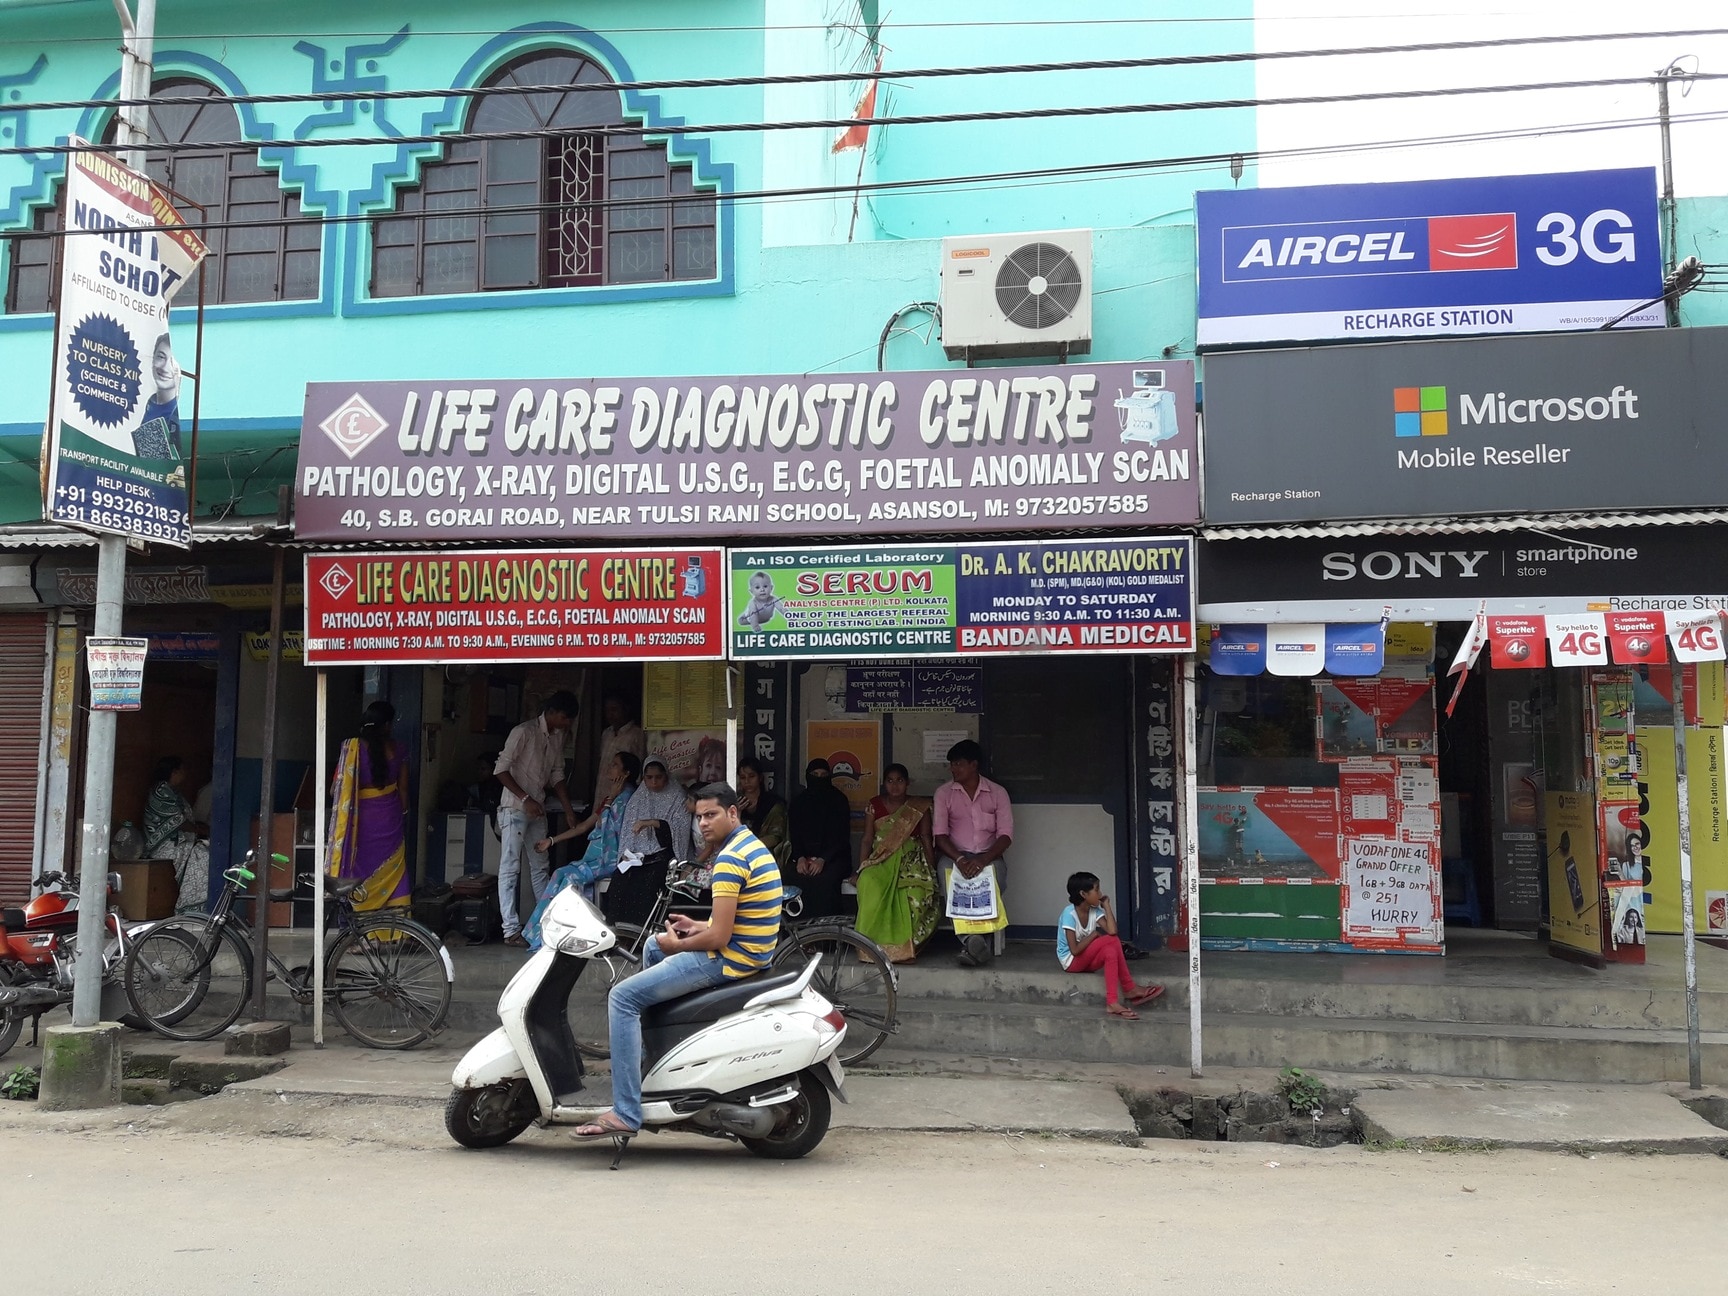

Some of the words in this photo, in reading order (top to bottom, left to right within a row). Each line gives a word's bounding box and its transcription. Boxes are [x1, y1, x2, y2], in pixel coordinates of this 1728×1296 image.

[76, 150, 149, 202] ADMISSION
[75, 199, 142, 257] NORTH
[1238, 231, 1416, 269] AIRCEL
[1535, 209, 1636, 266] 3G
[71, 272, 117, 301] AFFILIATED
[119, 294, 130, 307] TO
[132, 299, 155, 317] CBSE
[1344, 312, 1436, 331] RECHARGE
[1441, 308, 1514, 327] STATION
[82, 337, 128, 362] NURSERY
[73, 350, 87, 363] TO
[89, 356, 122, 378] CLASS
[124, 367, 139, 381] XII
[80, 371, 119, 390] (SCIENCE
[121, 383, 127, 392] &
[77, 383, 128, 409] COMMERCE)
[1460, 386, 1639, 425] Microsoft
[398, 388, 498, 455] LIFE
[504, 386, 622, 455] CARE
[629, 381, 898, 452] DIAGNOSTIC
[920, 373, 1099, 448] CENTRE
[60, 447, 100, 465] TRANSPORT
[100, 457, 129, 473] FACILITY
[130, 466, 164, 482] AVAILABLE
[1398, 447, 1476, 469] Mobile
[1483, 444, 1571, 466] Reseller
[96, 475, 123, 491] HELP
[125, 483, 151, 499] DESK
[303, 466, 467, 503] PATHOLOGY,
[475, 465, 557, 502] X-RAY,
[565, 463, 670, 497] DIGITAL
[679, 462, 765, 498] U.S.G.,
[773, 460, 852, 496] E.C.G,
[860, 457, 962, 490] FOETAL
[970, 453, 1104, 487] ANOMALY
[1112, 449, 1190, 482] SCAN
[56, 484, 86, 498] +91
[92, 490, 191, 527] 9932621836
[1231, 491, 1282, 505] Recharge
[1284, 489, 1321, 501] Station
[56, 505, 85, 521] +91
[91, 510, 191, 543] 8653839325
[340, 509, 371, 531] 40,
[379, 510, 419, 527] S.B.
[425, 508, 494, 526] GORAI
[500, 508, 566, 529] ROAD,
[572, 506, 631, 525] NEAR
[637, 505, 701, 524] TULSI
[707, 503, 760, 523] RANI
[766, 503, 862, 524] SCHOOL,
[868, 500, 977, 523] ASANSOL,
[984, 500, 1010, 517] M:
[1016, 494, 1149, 516] 9732057585
[746, 556, 766, 566] An
[770, 555, 795, 566] ISO
[799, 554, 861, 565] Certified
[866, 553, 944, 564] Laboratory
[994, 552, 1012, 575] A.
[1018, 551, 1037, 575] K.
[1042, 547, 1184, 573] CHAKRAVORTY
[1322, 550, 1489, 581] SONY
[1516, 544, 1638, 567] smartphone
[356, 562, 394, 604] LIFE
[399, 560, 452, 603] CARE
[458, 558, 588, 603] DIAGNOSTIC
[600, 557, 676, 600] CENTRE
[796, 569, 933, 596] SERUM
[1127, 575, 1147, 586] GOLD
[1148, 574, 1184, 586] MEDALIST
[1517, 565, 1547, 578] store
[784, 599, 828, 608] ANALYSIS
[830, 599, 866, 608] CENTRE
[869, 599, 881, 608] (P)
[883, 598, 903, 607] LTD.
[905, 597, 949, 606] KOLKATA
[992, 596, 1053, 608] MONDAY
[1057, 595, 1077, 606] TO
[1080, 593, 1157, 605] SATURDAY
[1610, 597, 1687, 611] Recharge
[322, 611, 393, 630] PATHOLOGY,
[396, 611, 433, 629] X-RAY,
[436, 610, 482, 626] DIGITAL
[565, 608, 609, 625] FOETAL
[613, 607, 670, 624] ANOMALY
[673, 607, 705, 624] SCAN
[784, 611, 807, 620] ONE
[809, 611, 823, 619] OF
[826, 610, 848, 619] THE
[850, 609, 898, 618] LARGEST
[901, 608, 949, 617] REFERAL
[788, 620, 823, 629] BLOOD
[826, 619, 867, 628] TESTING
[870, 618, 899, 627] LAB.
[902, 618, 914, 626] IN
[916, 617, 946, 626] INDIA
[970, 611, 1031, 623] MORNING
[1034, 610, 1061, 622] 9:30
[1064, 609, 1091, 621] A.M.
[1094, 609, 1112, 620] TO
[1115, 608, 1150, 619] 11:30
[1154, 607, 1182, 618] A.M.
[1675, 620, 1689, 628] Say
[1690, 619, 1704, 627] hello
[737, 634, 766, 649] LIFE
[769, 633, 806, 647] CARE
[809, 632, 893, 647] DIAGNOSTIC
[896, 630, 952, 645] CENTRE
[961, 626, 1075, 648] BANDANA
[1080, 624, 1187, 645] MEDICAL
[1556, 624, 1571, 632] Say
[1678, 627, 1720, 651] 4G
[353, 637, 399, 649] MORNING
[402, 636, 422, 648] 7:30
[424, 636, 445, 648] A.M.
[447, 636, 461, 648] TO
[463, 636, 483, 647] 9:30
[485, 635, 509, 649] A.M.,
[511, 634, 555, 647] EVENING
[557, 634, 563, 646] 6
[565, 634, 584, 646] P.M.
[587, 634, 600, 646] TO
[602, 634, 609, 646] 8
[649, 632, 706, 645] 9732057585
[1507, 639, 1527, 655] 4G
[1559, 633, 1601, 656] 4G
[1627, 636, 1648, 653] 4G
[670, 738, 691, 751] Care
[1710, 777, 1719, 806] Station
[1711, 807, 1720, 842] Recharge
[1353, 844, 1413, 859] VODAFONE
[1356, 858, 1387, 870] GRAND
[1389, 860, 1421, 875] OFFER
[1360, 875, 1377, 888] 1GB
[1388, 876, 1405, 888] 9GB
[1408, 883, 1431, 892] DATA
[1361, 890, 1371, 900] @
[1375, 892, 1398, 905] 251
[1371, 908, 1419, 924] HURRY
[728, 1049, 783, 1065] Activa
